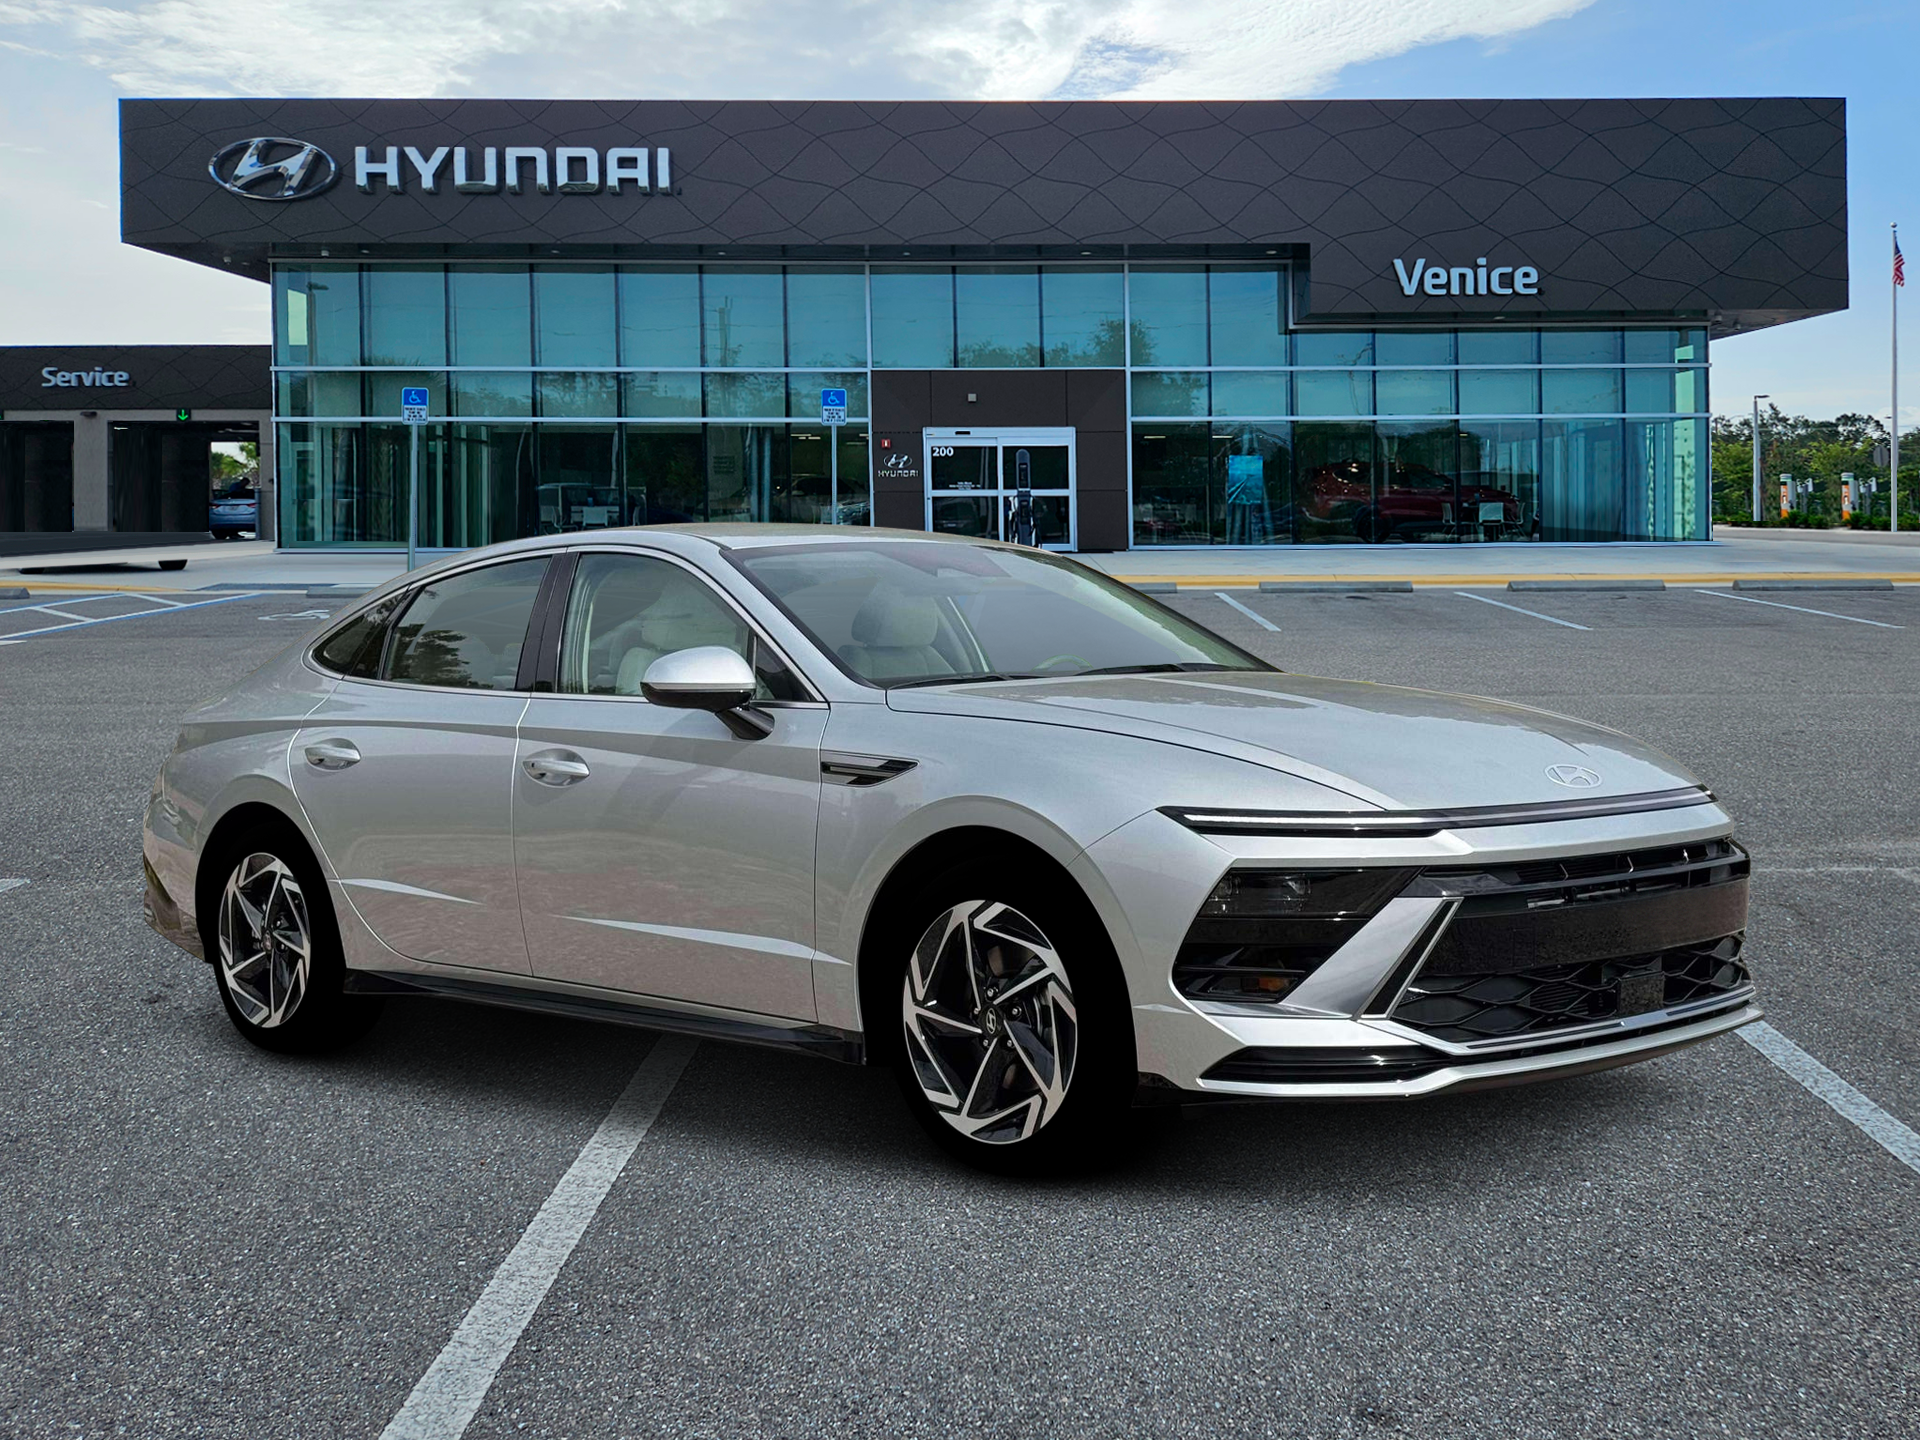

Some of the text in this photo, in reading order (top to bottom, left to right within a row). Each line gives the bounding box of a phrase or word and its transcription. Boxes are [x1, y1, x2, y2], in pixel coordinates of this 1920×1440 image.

[353, 146, 671, 195] HYUNDAI
[1392, 256, 1539, 296] Venice
[41, 366, 130, 387] Service
[932, 446, 955, 457] 200
[877, 470, 919, 478] HYUNDAI
